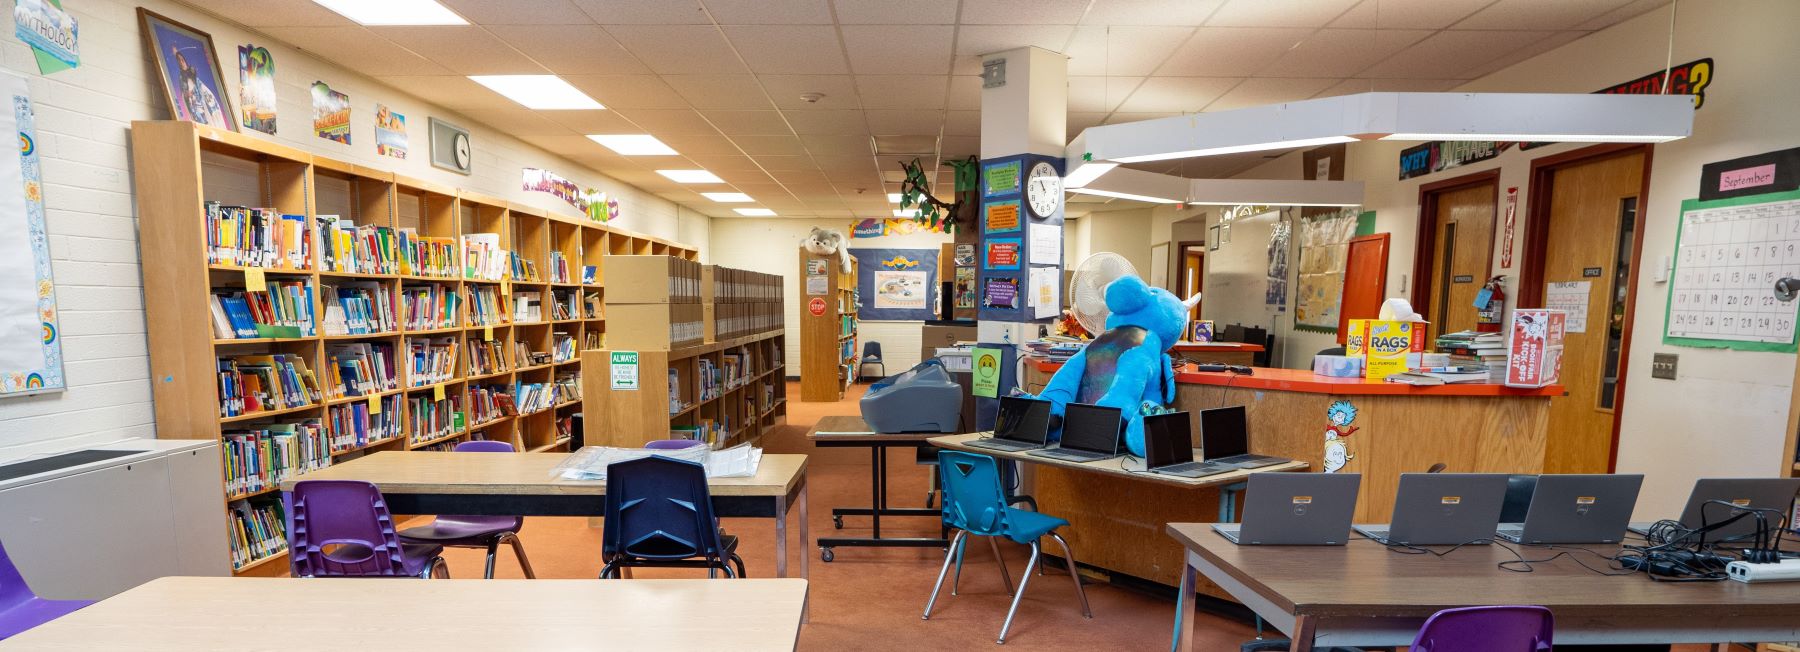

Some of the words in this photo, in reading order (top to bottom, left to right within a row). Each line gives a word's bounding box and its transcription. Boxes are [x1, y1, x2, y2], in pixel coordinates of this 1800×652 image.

[16, 12, 76, 52] MYTHOLOGY
[1402, 148, 1429, 173] WHY
[1724, 171, 1771, 189] September
[1792, 220, 1800, 233] 2
[1734, 248, 1740, 259] 6
[1753, 246, 1760, 257] 7
[1771, 246, 1778, 258] 8
[1787, 244, 1794, 257] 9
[1713, 272, 1720, 282] 12
[1731, 271, 1740, 283] 13
[1748, 272, 1757, 283] 14
[1764, 271, 1774, 283] 15
[1711, 294, 1718, 305] 19
[1727, 295, 1737, 305] 20
[1743, 295, 1753, 306] 21
[1762, 296, 1774, 306] 22
[1705, 316, 1714, 326] 26
[1723, 317, 1733, 327] 27
[1741, 317, 1752, 328] 28
[1759, 318, 1770, 330] 29
[1776, 319, 1789, 331] 30
[1371, 336, 1409, 348] RAGS
[613, 354, 637, 363] ALWAYS
[1518, 340, 1530, 382] KICK-OFF
